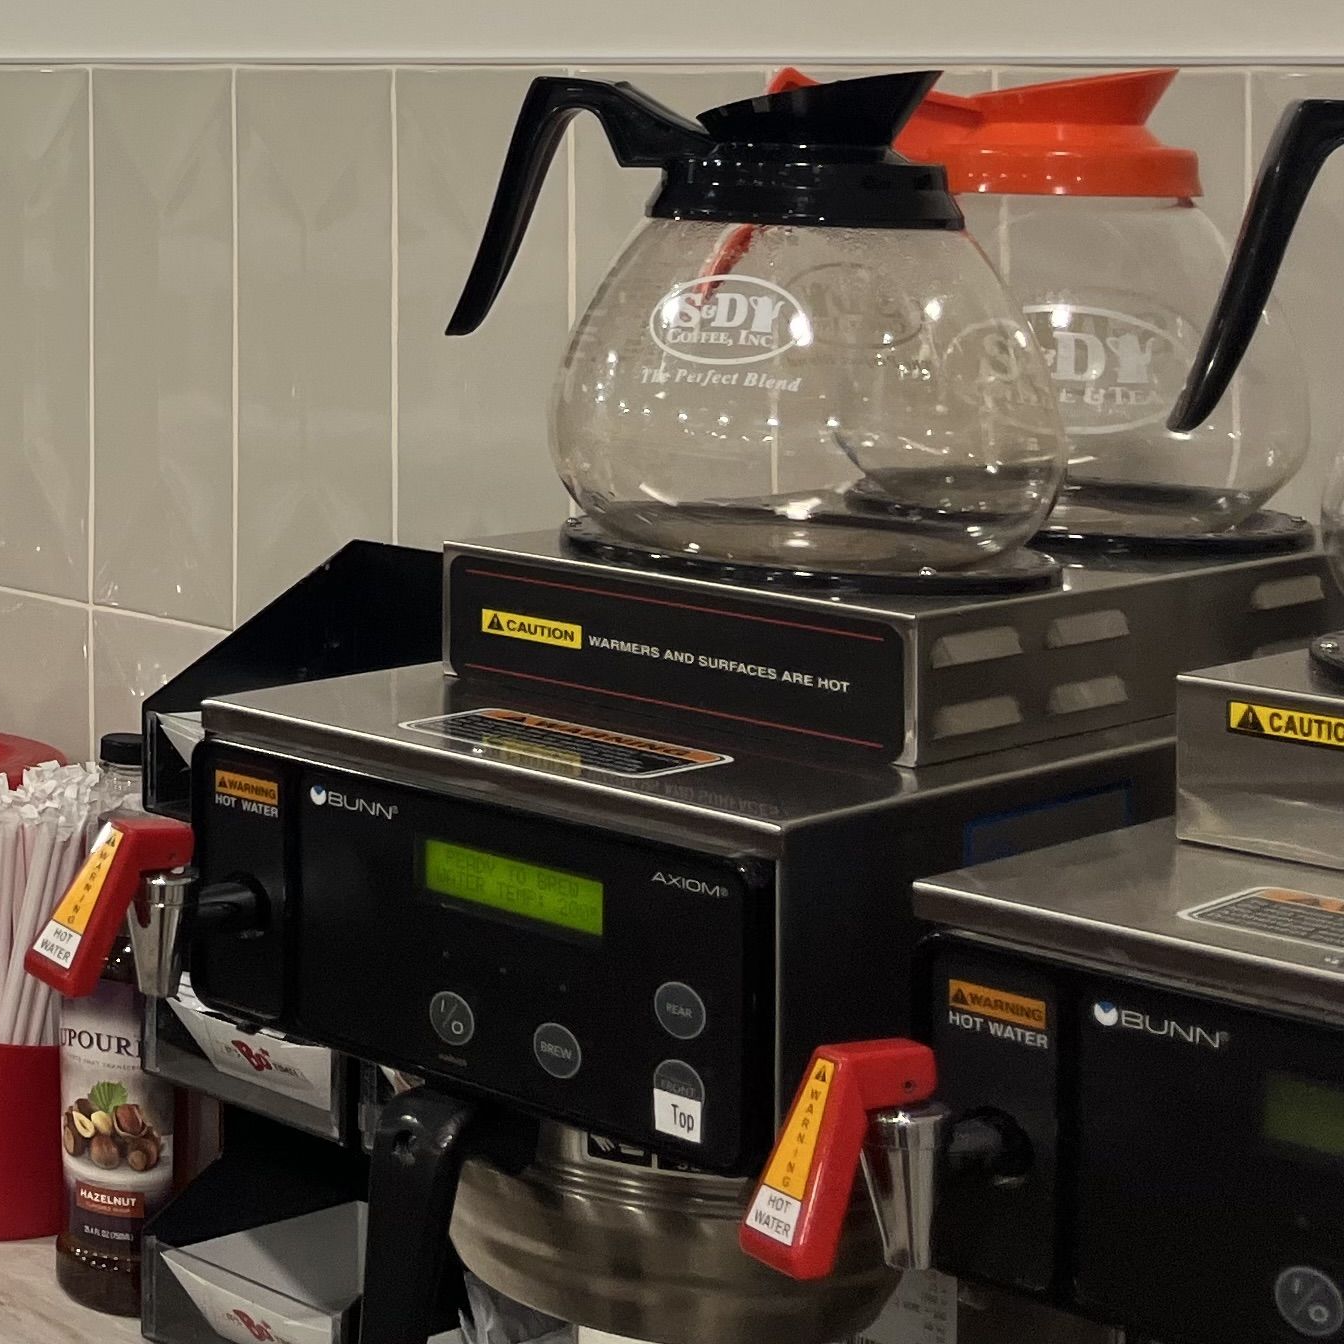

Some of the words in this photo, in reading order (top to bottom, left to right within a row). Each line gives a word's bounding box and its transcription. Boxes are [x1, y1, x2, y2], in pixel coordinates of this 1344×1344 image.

[641, 366, 671, 384] The
[675, 369, 738, 386] Perfect
[744, 372, 802, 392] Blend
[506, 620, 575, 642] CAUTION
[589, 635, 660, 658] WARMERS
[664, 650, 694, 664] AND
[698, 656, 778, 680] SURFACES
[782, 670, 814, 687] ARE
[818, 677, 850, 693] HOT
[228, 779, 276, 799] WARNING
[216, 794, 237, 808] HOT
[242, 800, 278, 818] WATER
[68, 851, 108, 924] WARNING
[53, 929, 73, 943] HOT
[40, 939, 71, 963] WATER
[666, 1004, 692, 1018] REAR
[968, 992, 1042, 1022] WARNING
[949, 1012, 983, 1030] HOT
[988, 1020, 1048, 1048] WATER
[540, 1041, 571, 1060] BREW
[670, 1104, 694, 1134] Top
[782, 1089, 821, 1187] WARNING
[80, 1188, 136, 1207] HAZELNUT
[767, 1193, 791, 1213] HOT
[754, 1210, 791, 1238] WATER
